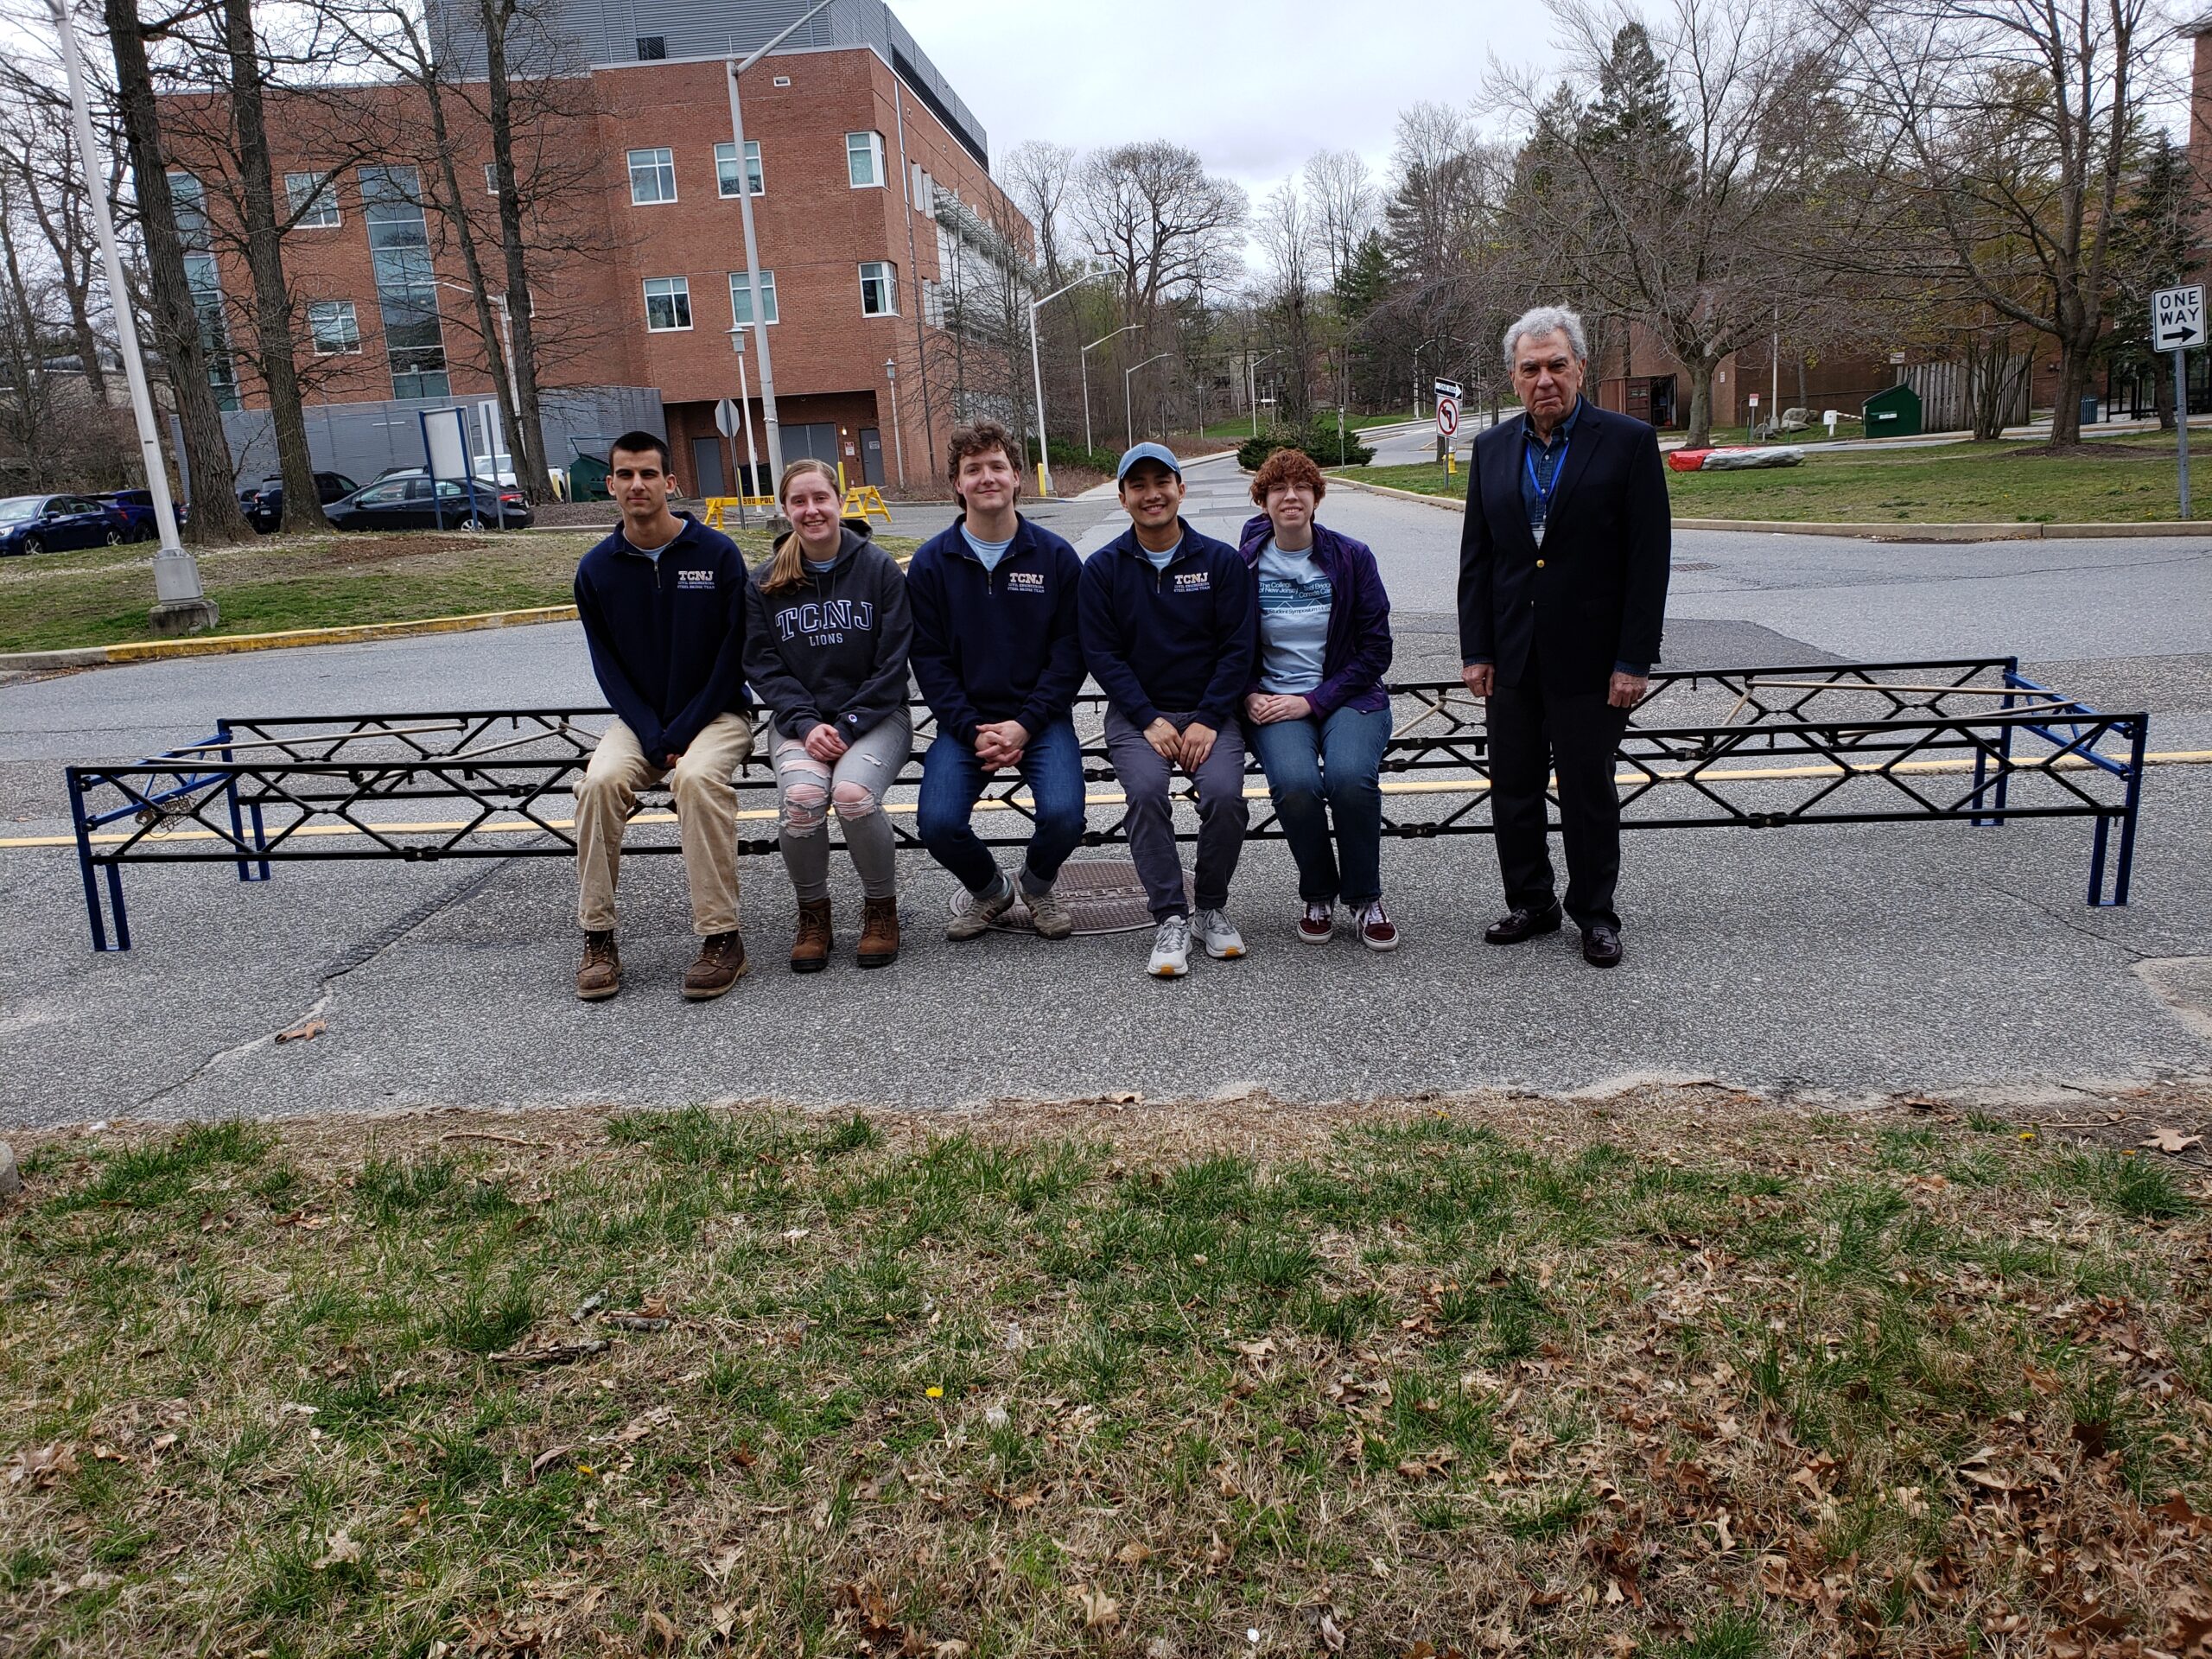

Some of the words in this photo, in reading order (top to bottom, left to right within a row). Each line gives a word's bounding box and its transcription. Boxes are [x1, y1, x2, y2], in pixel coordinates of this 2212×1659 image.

[2160, 290, 2199, 309] ONE
[2160, 307, 2200, 326] WAY
[678, 570, 714, 581] TCNJ
[1009, 572, 1044, 585] TCNJ
[1174, 571, 1208, 585] TCNJ
[775, 600, 873, 642] TCNJ
[809, 632, 843, 646] LIONS
